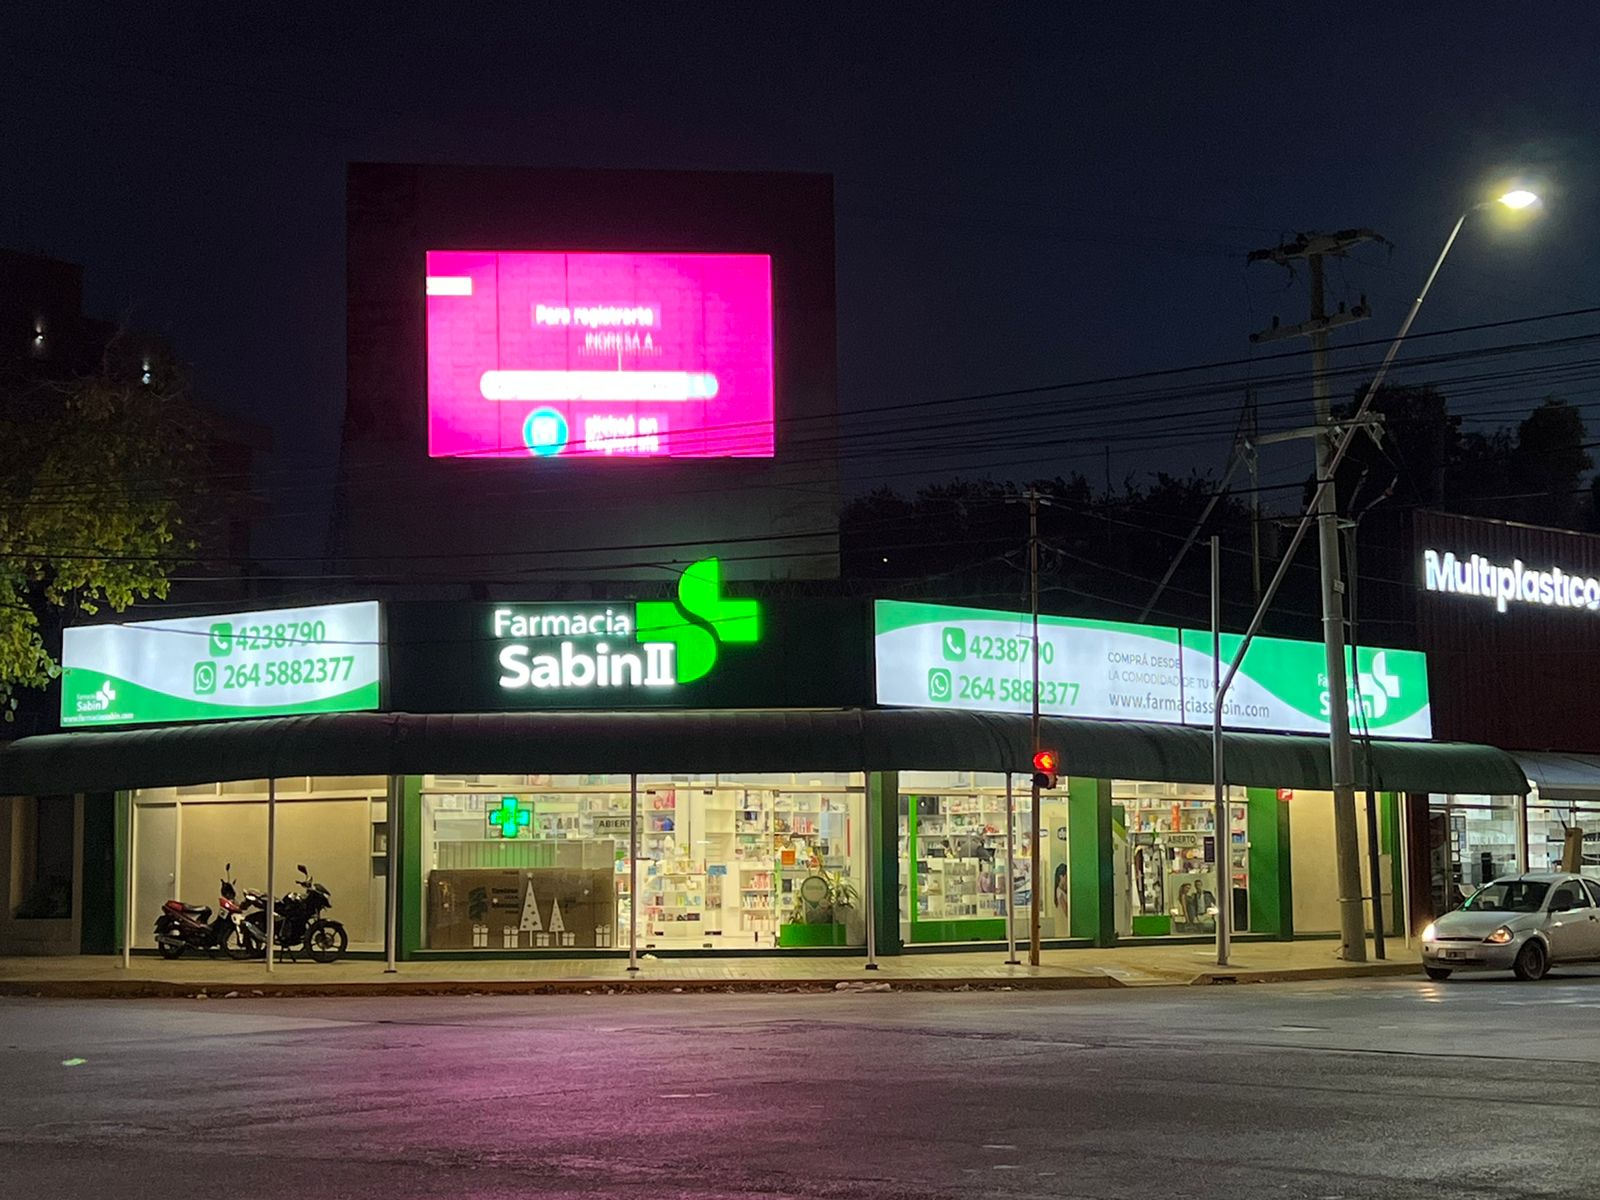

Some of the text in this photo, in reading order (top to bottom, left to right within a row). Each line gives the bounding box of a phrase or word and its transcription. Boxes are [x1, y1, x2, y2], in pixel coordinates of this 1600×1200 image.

[236, 620, 326, 652] 4238790
[493, 609, 630, 638] Farmacia
[969, 635, 1054, 665] 423870
[1107, 652, 1181, 669] COMPRÁ DESDE
[223, 656, 355, 689] 264 5882377
[1108, 670, 1120, 681] LA
[1183, 677, 1195, 688] DE
[1197, 678, 1209, 689] TU
[959, 675, 995, 701] 264
[76, 700, 101, 712] Sabin
[1108, 692, 1270, 718] www.farmaciassbin.com
[598, 819, 638, 828] ABIERT
